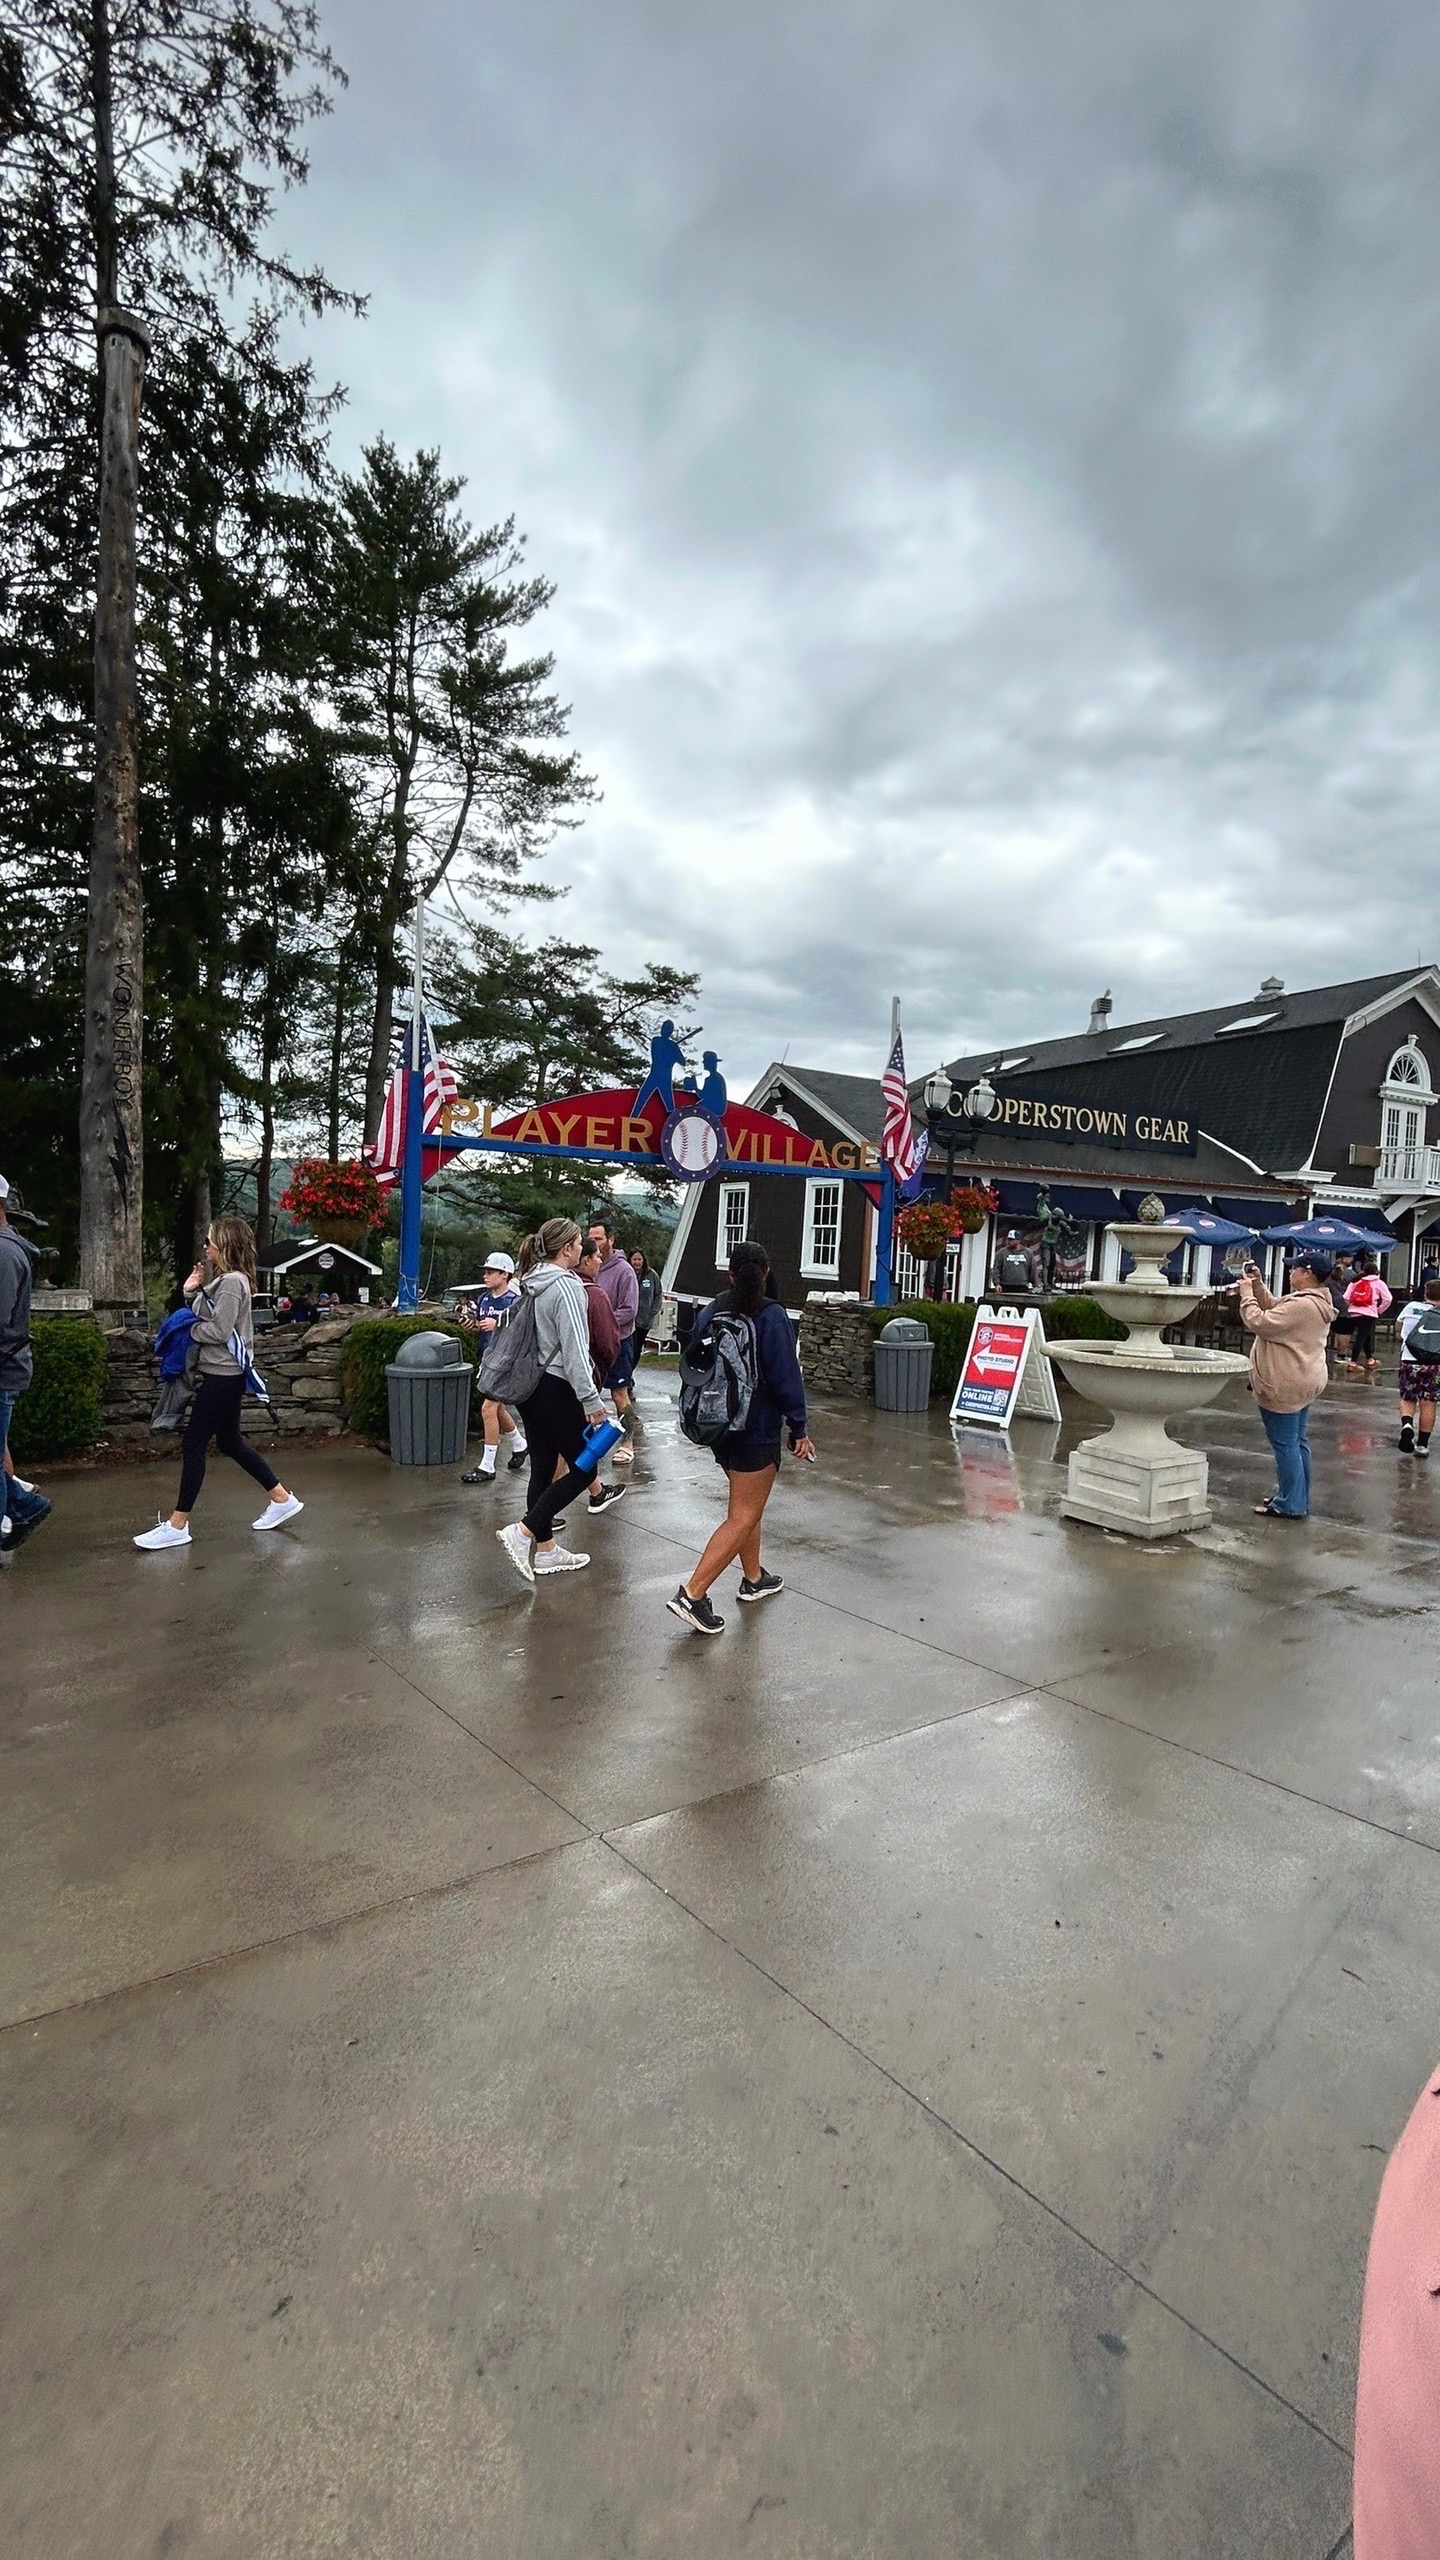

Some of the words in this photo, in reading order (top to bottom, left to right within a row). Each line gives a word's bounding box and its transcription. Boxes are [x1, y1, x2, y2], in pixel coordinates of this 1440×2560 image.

[112, 962, 133, 1109] WONDERBOY
[440, 1098, 653, 1154] PLAYER
[724, 1127, 882, 1173] VILLAGE
[1135, 1115, 1190, 1144] GEAR
[976, 1355, 995, 1363] PHOTO
[995, 1356, 1015, 1365] STUDIO
[961, 1391, 993, 1403] ONLINE
